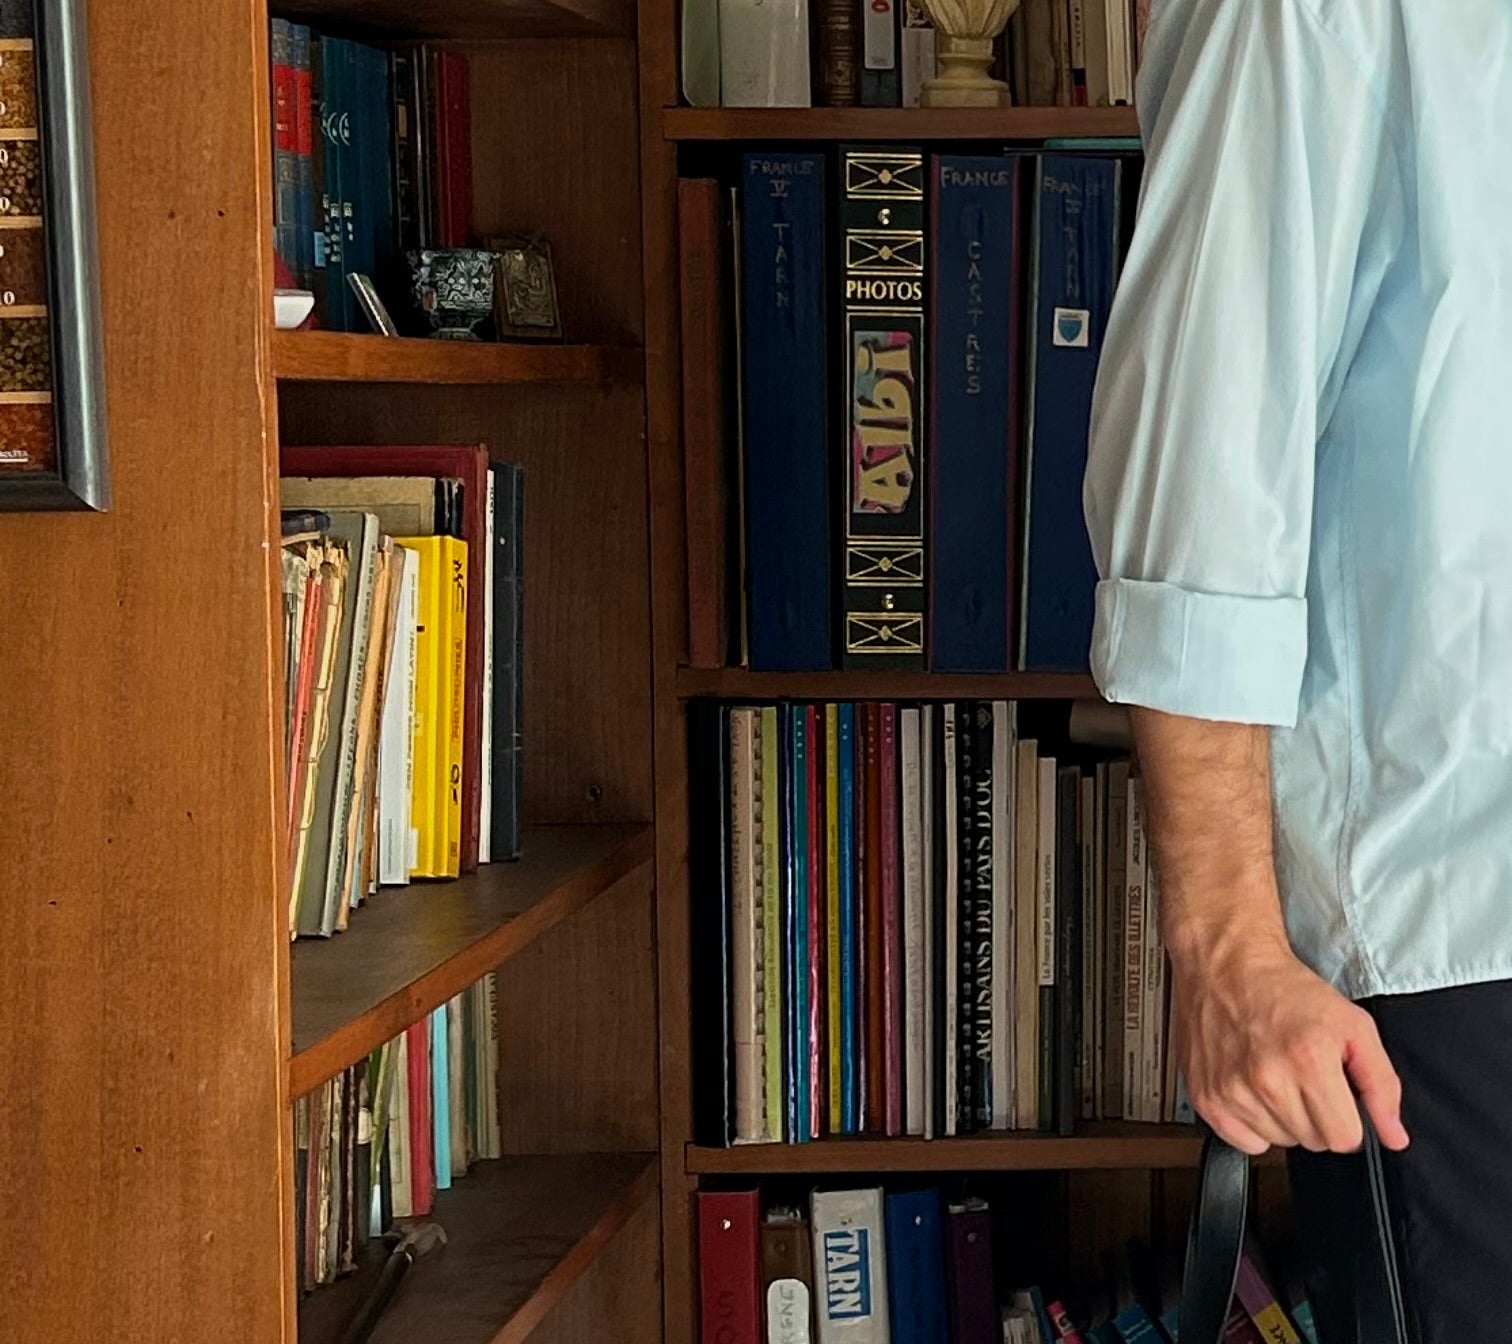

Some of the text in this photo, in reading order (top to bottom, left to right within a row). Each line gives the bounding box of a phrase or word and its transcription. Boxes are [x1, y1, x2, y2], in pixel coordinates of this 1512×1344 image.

[940, 166, 1010, 188] FRANCE
[847, 281, 922, 301] PHOTOS
[855, 336, 914, 511] Albi
[976, 835, 990, 890] PAYS
[976, 898, 990, 933] DU
[977, 940, 991, 1062] ARTISANS
[825, 1228, 861, 1315] TARN
